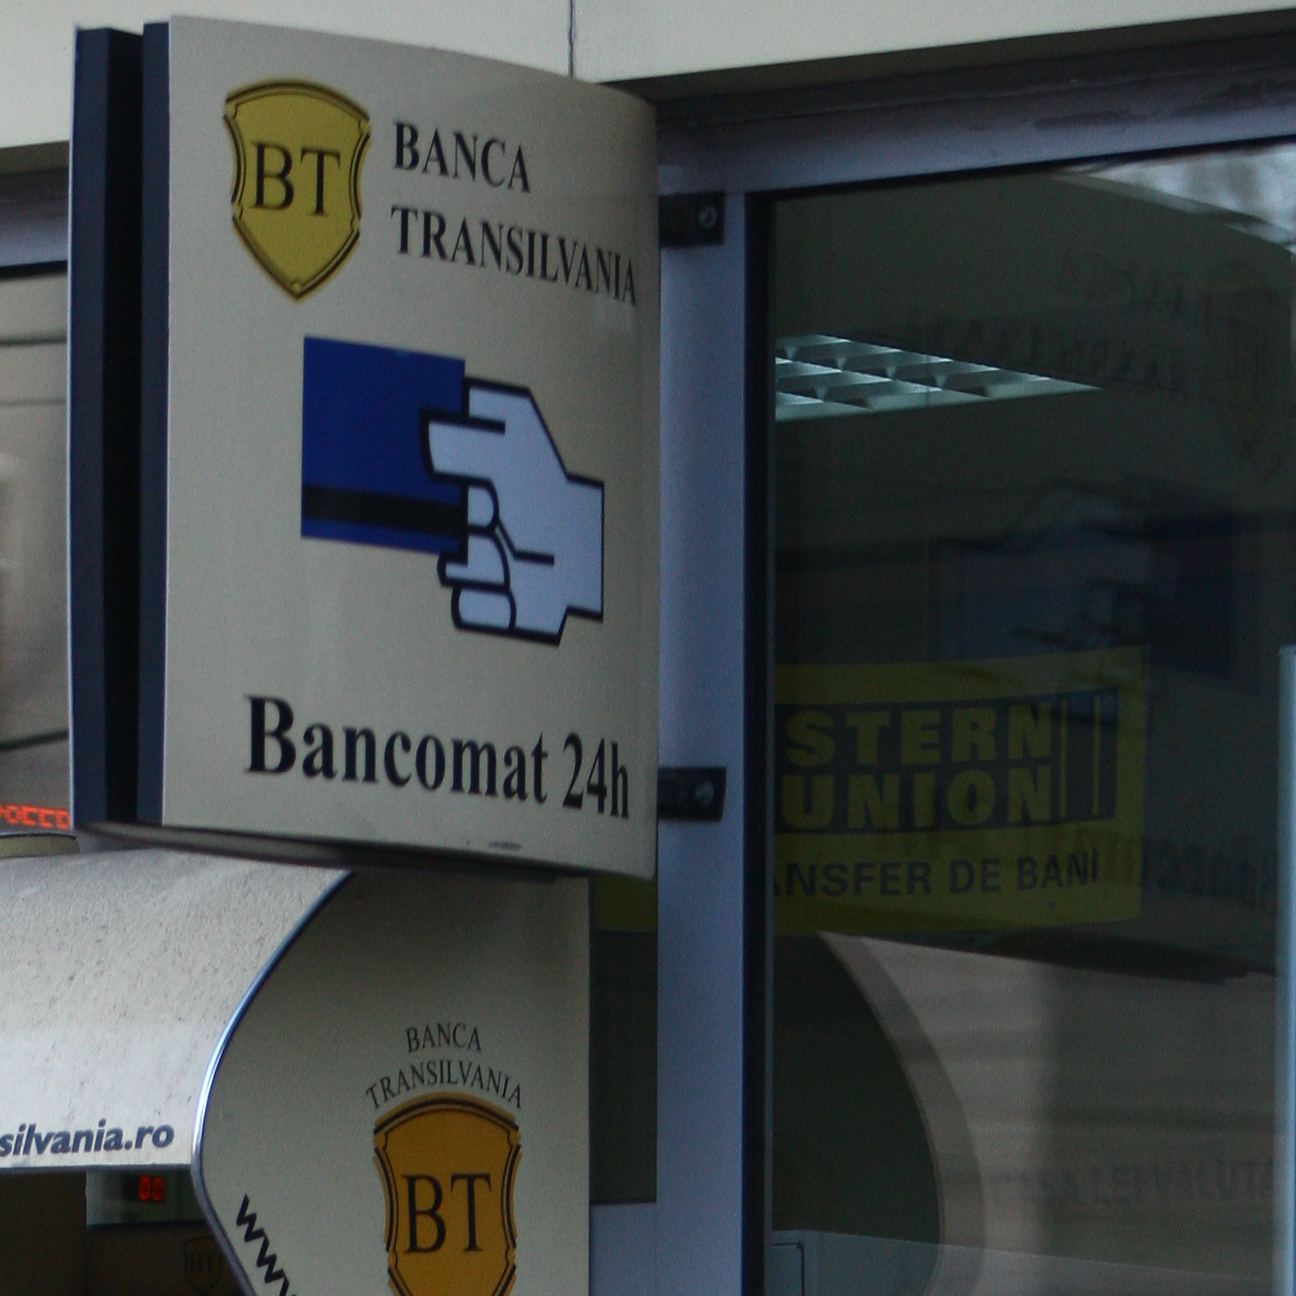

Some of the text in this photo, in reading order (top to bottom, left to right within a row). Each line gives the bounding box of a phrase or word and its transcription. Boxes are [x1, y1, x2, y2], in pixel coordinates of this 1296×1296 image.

[251, 142, 342, 217] BT
[393, 120, 532, 195] BANCA
[391, 205, 638, 306] TRANSILVANIA
[246, 694, 630, 820] Bancomat 24h
[785, 699, 1051, 768] STERN
[779, 765, 1052, 830] UNION
[771, 861, 932, 897] NSFER
[949, 858, 1001, 894] DE
[1016, 850, 1098, 891] BANI
[406, 1022, 482, 1053] BANCA
[365, 1058, 522, 1110] TRANSILVANIA
[401, 1172, 492, 1254] BT
